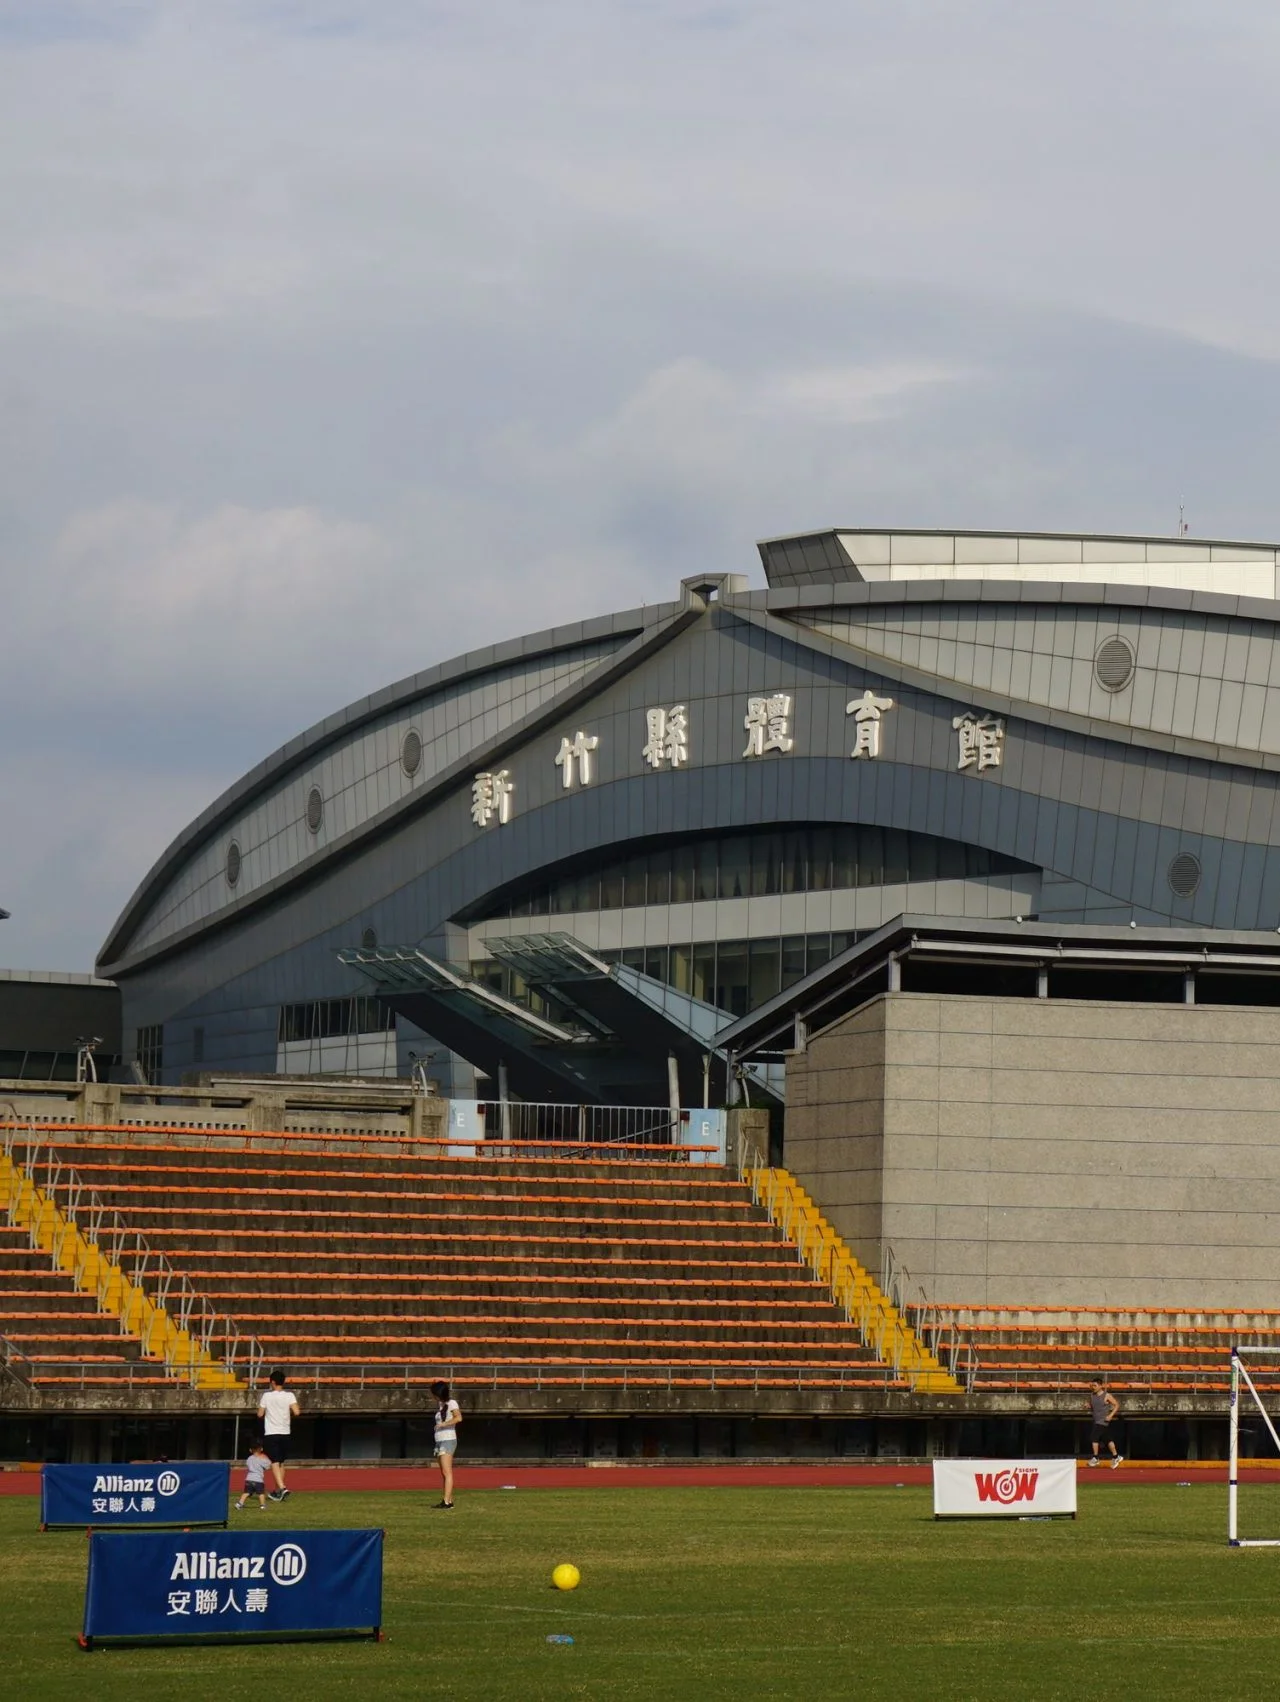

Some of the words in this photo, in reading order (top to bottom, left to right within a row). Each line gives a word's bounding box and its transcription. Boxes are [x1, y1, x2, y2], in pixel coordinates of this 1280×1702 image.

[470, 690, 1005, 827] 新竹縣體育館
[456, 1112, 465, 1127] E
[702, 1121, 710, 1136] E
[92, 1475, 154, 1492] Allianz
[975, 1469, 1040, 1504] WOW
[92, 1497, 156, 1513] 安聯人壽
[170, 1551, 265, 1580] Allianz
[166, 1588, 269, 1616] 安聯人壽
